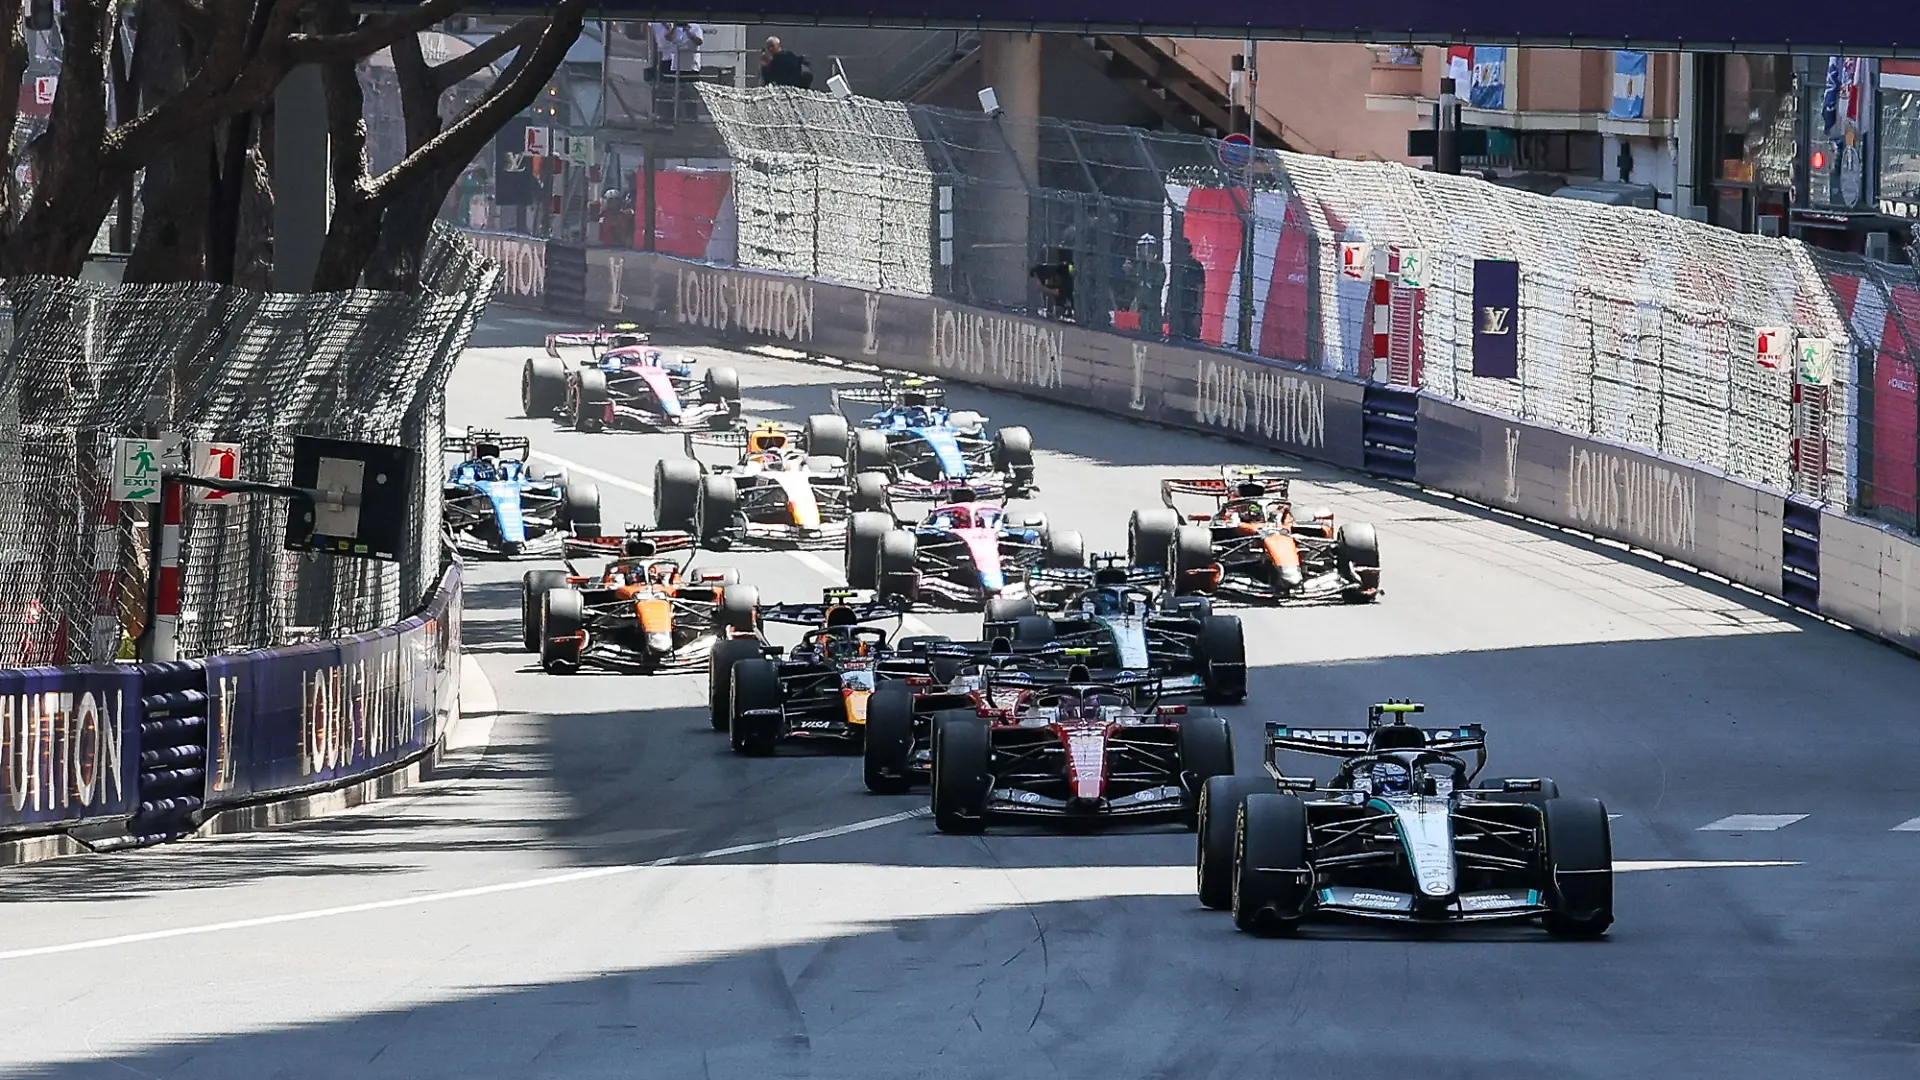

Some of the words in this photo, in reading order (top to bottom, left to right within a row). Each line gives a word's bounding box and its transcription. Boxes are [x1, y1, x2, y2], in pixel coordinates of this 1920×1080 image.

[676, 268, 728, 330] LOUIS
[734, 276, 815, 342] VUITTON
[1480, 306, 1510, 335] LV
[932, 307, 985, 375] LOUIS
[990, 317, 1063, 389] VUITTON
[1196, 359, 1248, 433] LOUIS
[1253, 371, 1325, 449] VUITTON
[123, 478, 158, 486] EXIT
[1568, 445, 1619, 530] LOUIS
[1623, 458, 1696, 553] VUITTON
[301, 658, 357, 777] LOUIS
[800, 721, 831, 729] VISA
[0, 688, 123, 812] UITTON
[1348, 897, 1398, 909] Syntium
[1353, 892, 1401, 902] PETRONAS
[1465, 894, 1512, 903] PETRONAS
[1469, 898, 1517, 909] Syntium
